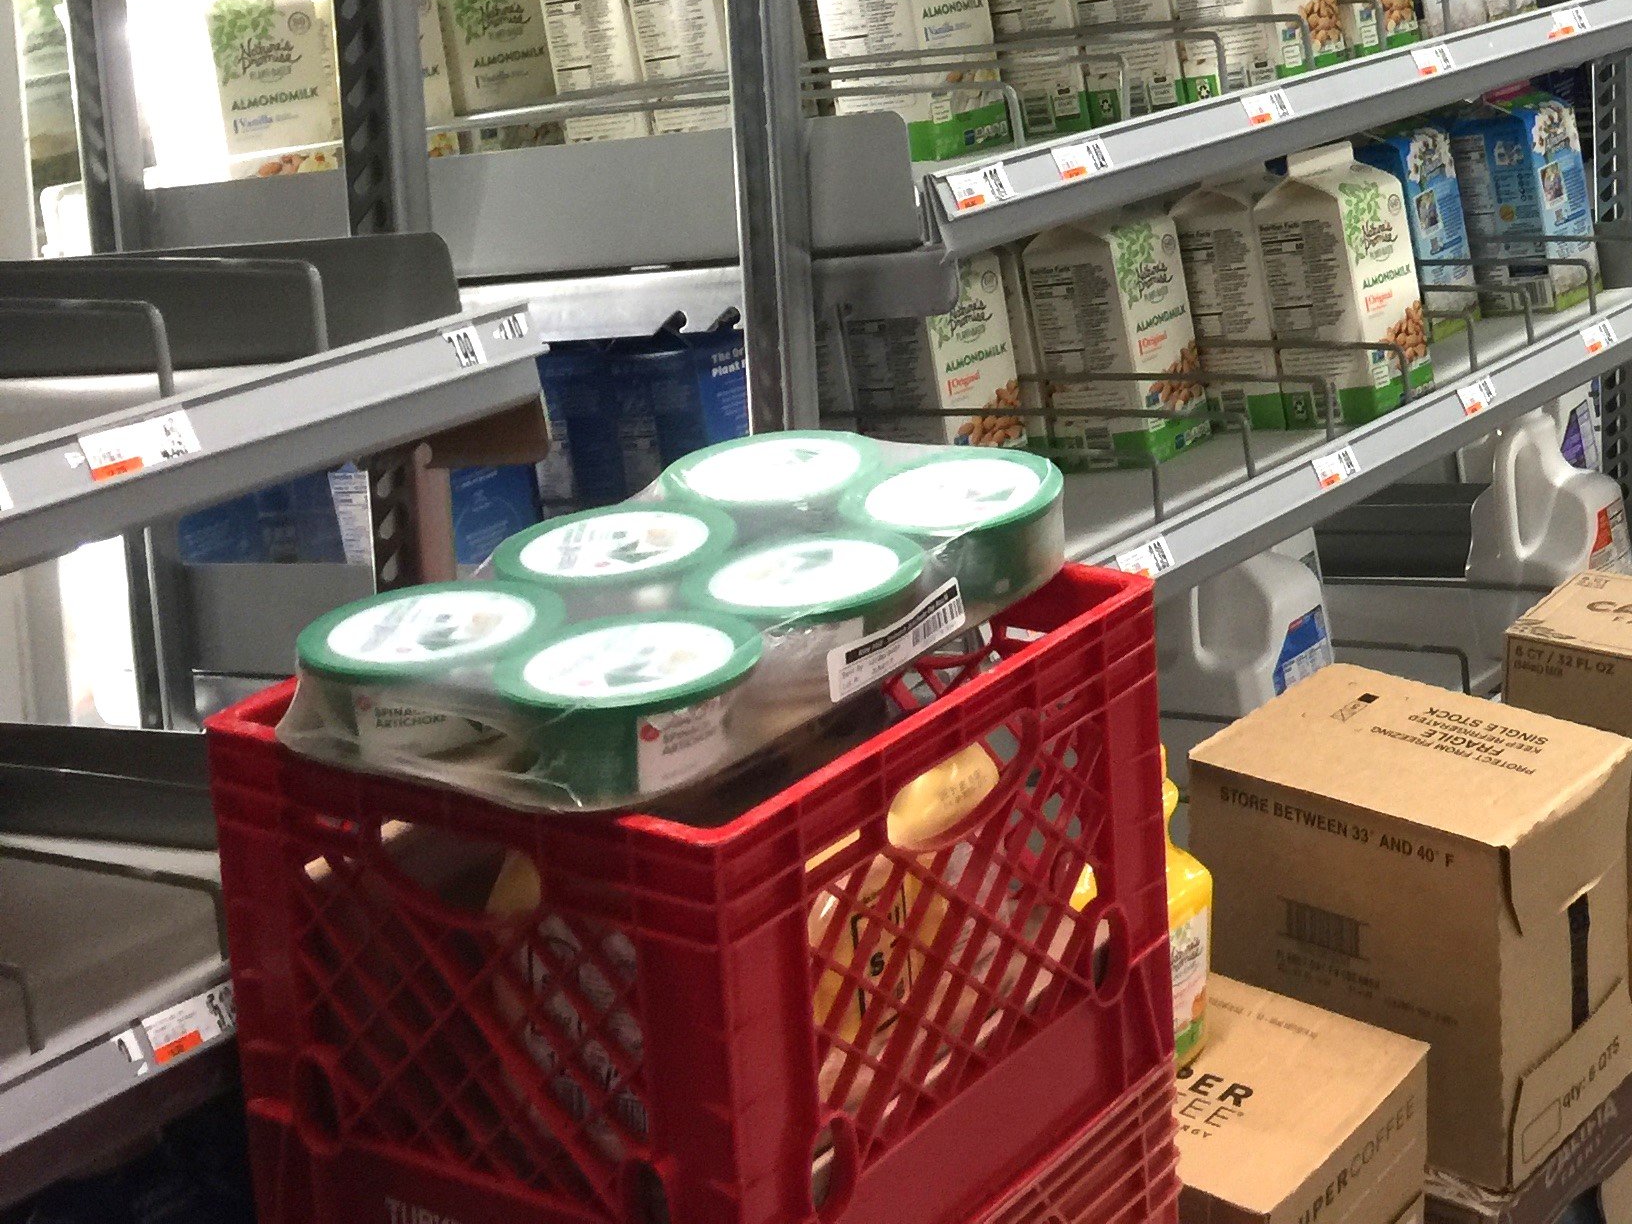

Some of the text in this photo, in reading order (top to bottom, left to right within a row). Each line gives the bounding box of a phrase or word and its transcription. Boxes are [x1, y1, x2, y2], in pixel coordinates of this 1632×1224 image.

[473, 45, 546, 69] ALMONDMILK
[231, 86, 319, 111] ALMONDMILK
[1363, 263, 1412, 290] ALMONDMILK
[1136, 304, 1187, 333] ALMONDMILK
[945, 341, 1008, 374] ALMONDMILK
[950, 370, 981, 389] Original
[1596, 661, 1616, 676] OZ
[1408, 714, 1543, 755] KEEP REFRIGERATED
[1427, 707, 1549, 746] SINGLE STOCK
[1370, 725, 1537, 775] PROTECT FROM FREEZING
[1420, 728, 1505, 757] FRAGILE
[1219, 786, 1269, 814] STORE
[1273, 802, 1348, 839] BETWEEN
[1379, 833, 1413, 857] AND
[1444, 853, 1455, 868] F
[1598, 1035, 1620, 1072] QTS
[1176, 1066, 1254, 1108] PER
